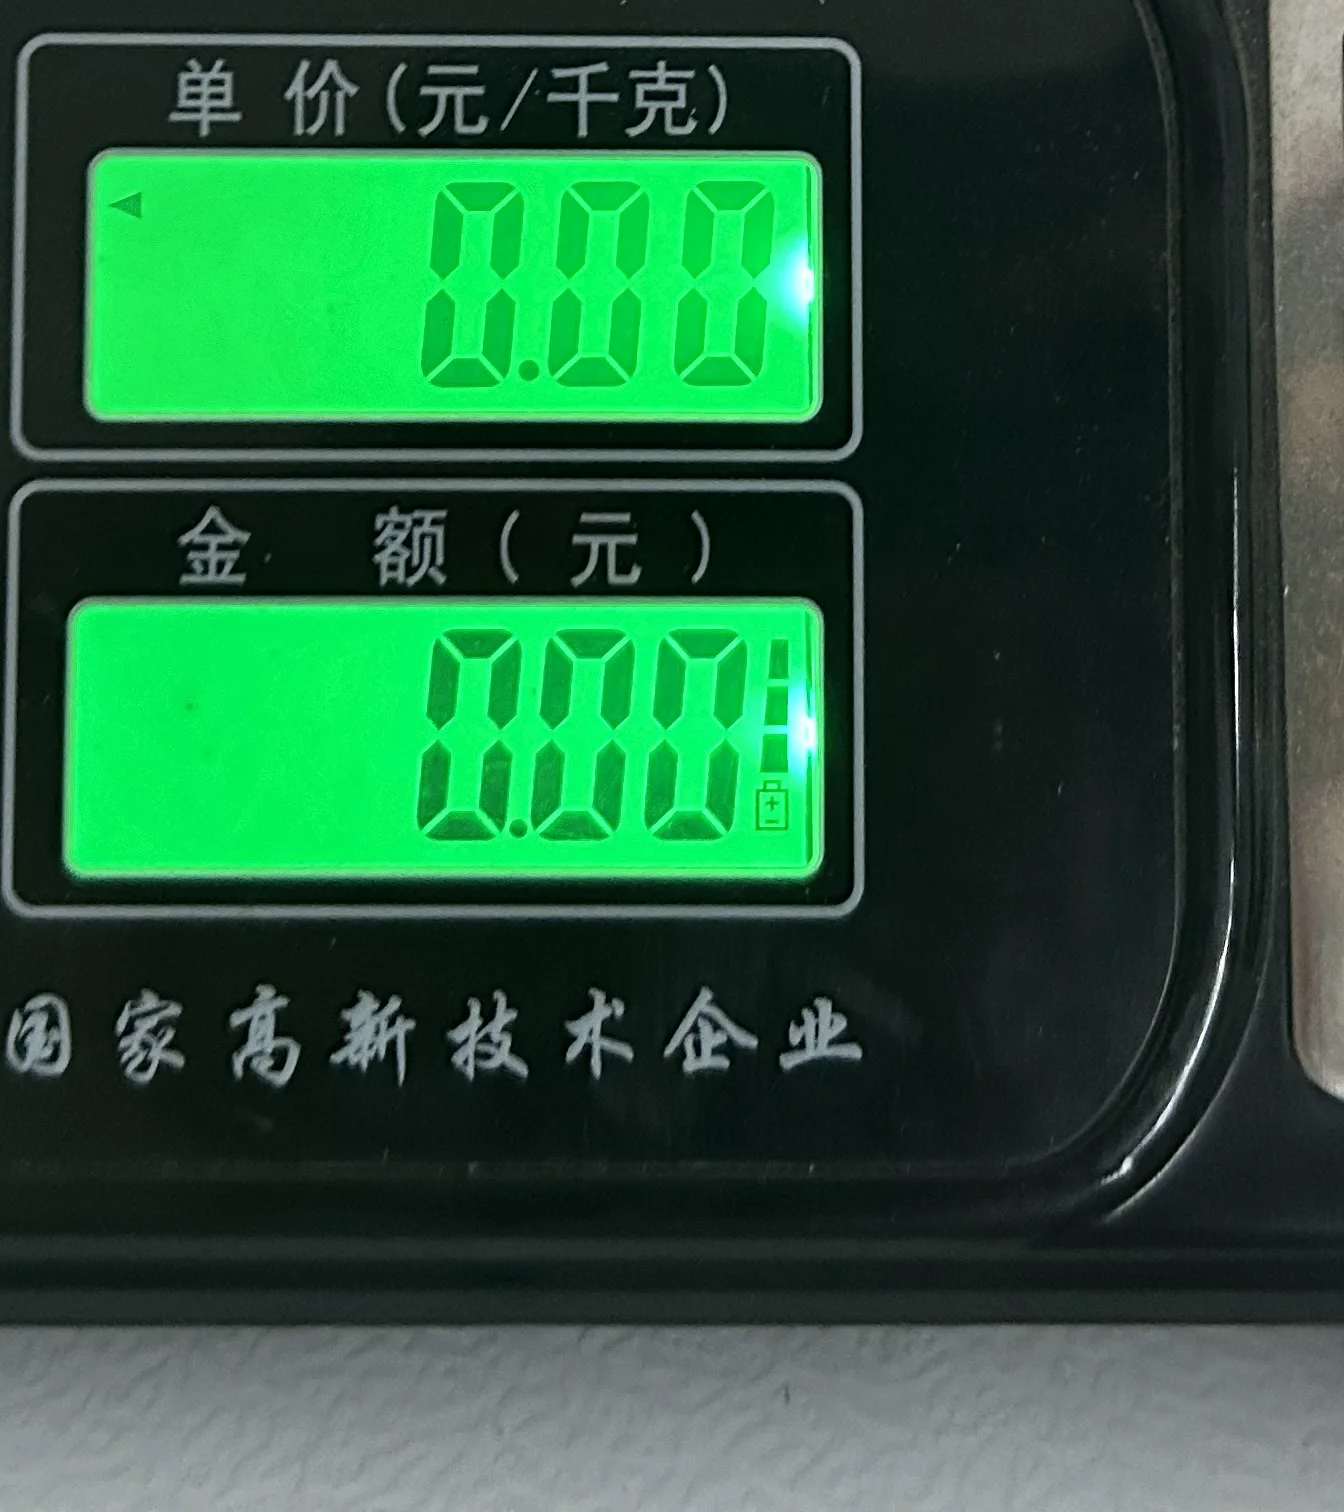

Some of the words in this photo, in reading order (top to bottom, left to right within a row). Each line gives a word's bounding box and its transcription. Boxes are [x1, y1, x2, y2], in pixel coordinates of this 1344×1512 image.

[420, 180, 776, 389] 0.00
[416, 628, 749, 842] 0.00
[5, 984, 863, 1088] 国家高新技术企业
